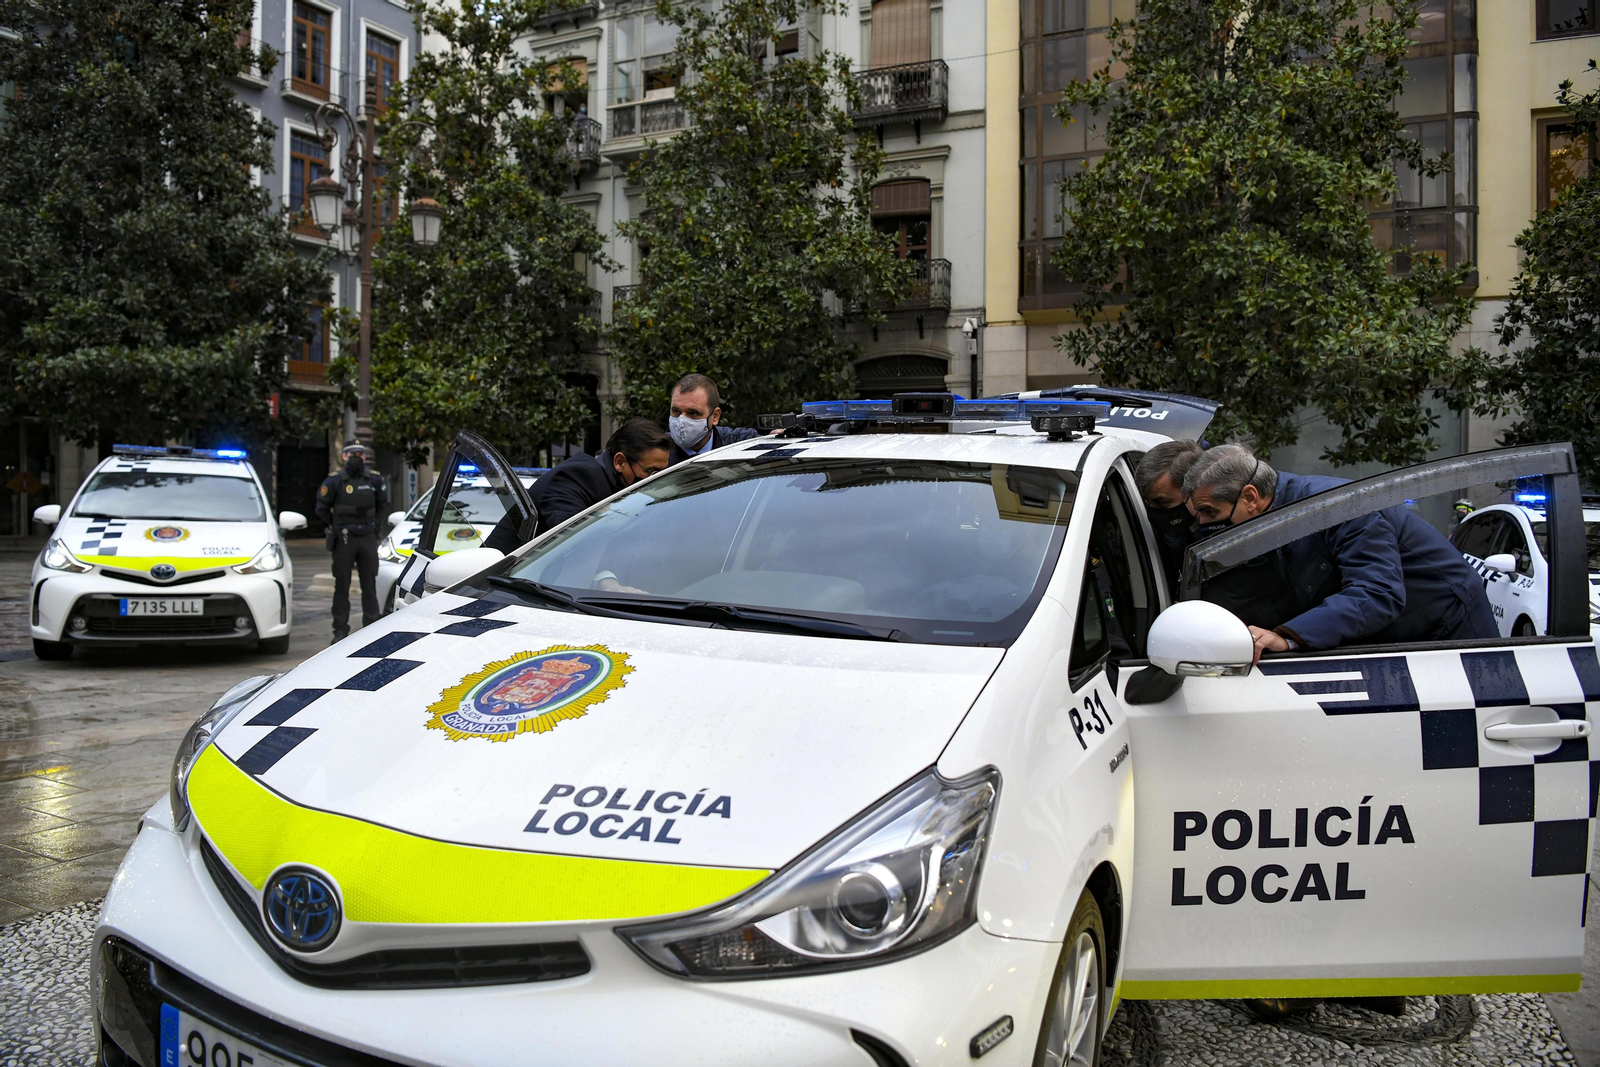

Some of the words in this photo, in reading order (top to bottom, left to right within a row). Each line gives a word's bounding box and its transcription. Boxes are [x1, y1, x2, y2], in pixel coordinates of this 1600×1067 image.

[1110, 406, 1169, 421] POLI
[131, 601, 167, 613] 7135
[172, 601, 199, 613] LLL
[445, 713, 510, 733] GRANADA
[490, 714, 530, 723] LOCAL
[1068, 688, 1113, 751] P-31
[539, 784, 732, 819] POLICÍA
[522, 809, 682, 845] LOCAL
[1173, 795, 1416, 852] POLICÍA
[1171, 862, 1367, 906] LOCAL
